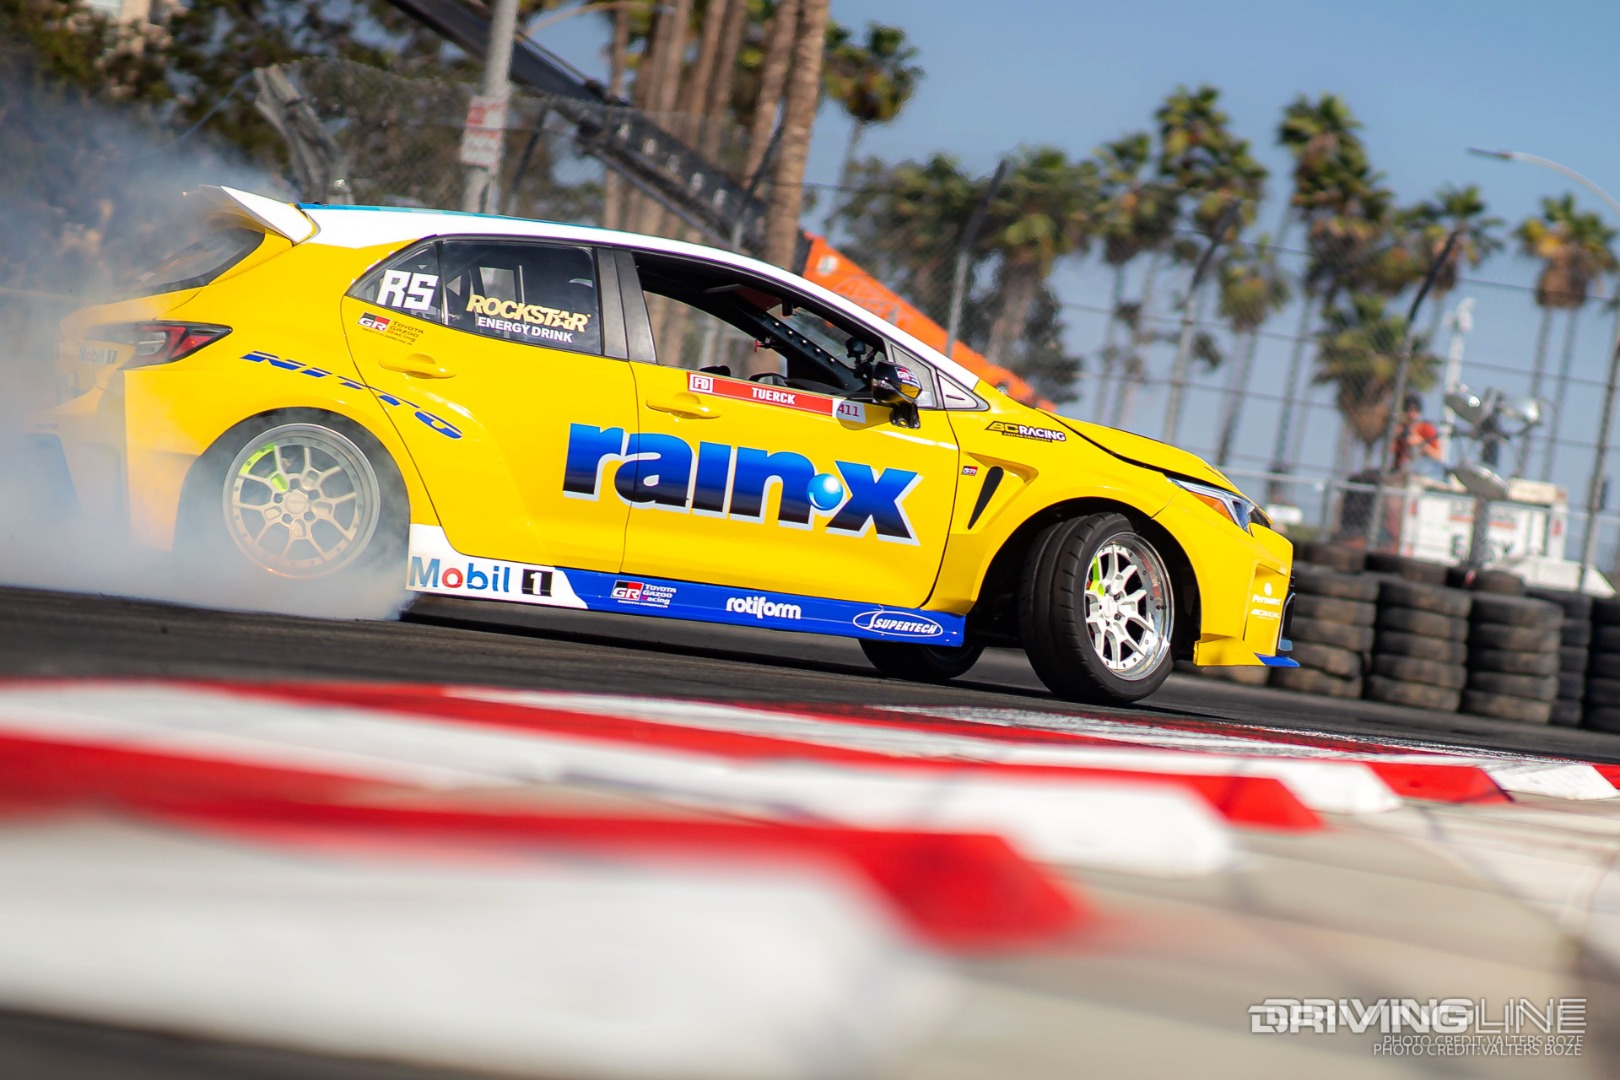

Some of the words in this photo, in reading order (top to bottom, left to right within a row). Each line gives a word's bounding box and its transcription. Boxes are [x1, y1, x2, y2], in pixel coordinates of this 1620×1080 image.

[376, 269, 439, 311] RS
[466, 294, 588, 332] ROCKSTAR
[358, 317, 388, 332] GR
[389, 325, 419, 338] GAZOO
[393, 320, 424, 334] TOYOTA
[477, 317, 531, 335] ENERGY
[531, 326, 573, 343] DRINK
[752, 387, 796, 405] TUERCK
[837, 403, 860, 418] 411
[408, 556, 511, 593] Mobil
[612, 587, 640, 600] GR
[642, 589, 673, 598] GAZOO
[645, 584, 677, 593] TOYOTA
[726, 597, 801, 619] rotiform
